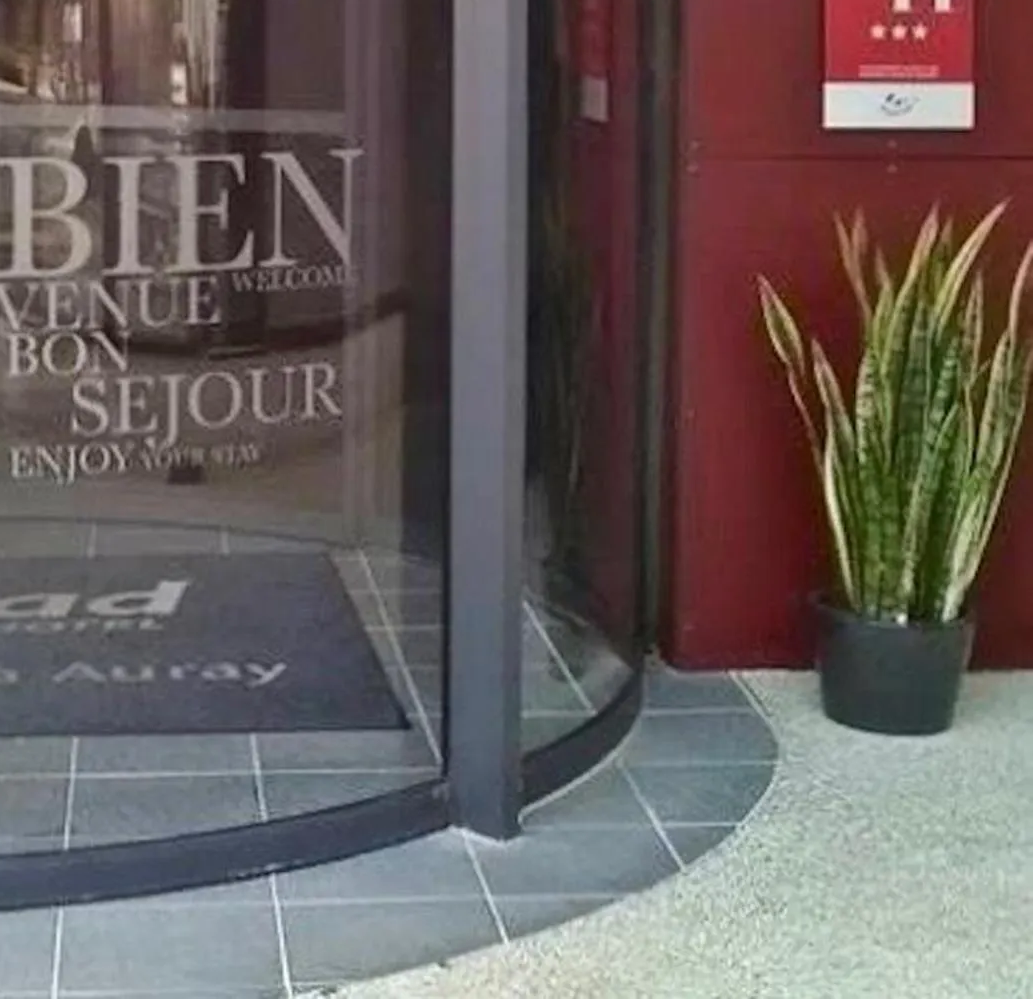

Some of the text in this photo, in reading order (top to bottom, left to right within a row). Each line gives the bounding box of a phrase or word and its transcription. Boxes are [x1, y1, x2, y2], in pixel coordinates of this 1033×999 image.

[8, 331, 130, 377] BON
[72, 362, 344, 449] SEJOUR
[9, 444, 132, 485] ENJOY
[51, 661, 288, 687] Auray
